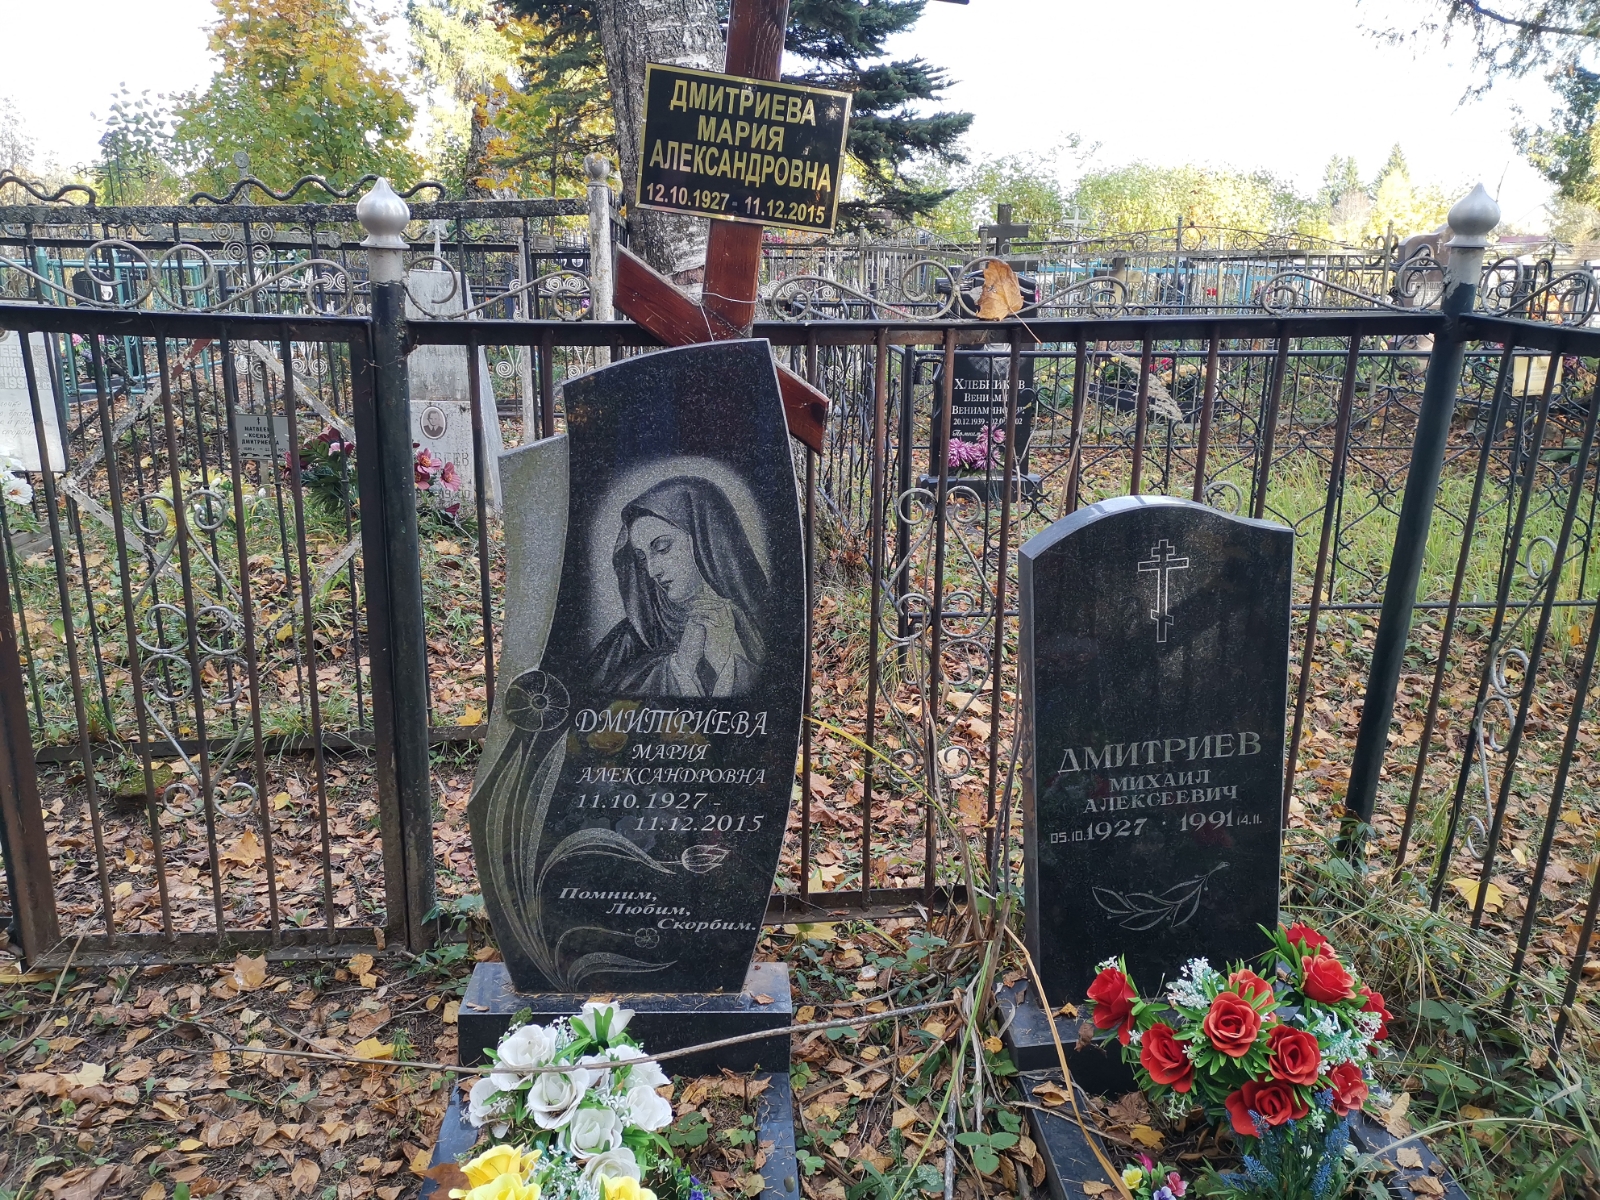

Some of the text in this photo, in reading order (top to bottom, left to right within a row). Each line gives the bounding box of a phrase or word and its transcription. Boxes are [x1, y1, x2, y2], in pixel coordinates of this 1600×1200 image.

[669, 79, 816, 126] ДМИТРИЕВА
[697, 115, 785, 152] МАРИЯ
[649, 139, 831, 193] АЛЕКСАНДРОВНА
[647, 182, 730, 211] 12.10.1927
[744, 196, 826, 224] 11.12.2015
[575, 707, 769, 738] ДМИТРИЕВА
[632, 743, 711, 763] МАРИЯ
[1057, 731, 1262, 774] ДМИТРИЕВ
[576, 767, 766, 785] АЛЕКСАНДРОВНА
[1109, 769, 1211, 793] МИХАИЛ
[576, 792, 709, 810] 11.10.1927
[1083, 785, 1238, 814] АЛЕКСЕЕВИЧ
[634, 814, 766, 832] 11.12.2015
[559, 887, 658, 902] Помним,
[606, 903, 692, 917] Любим,
[657, 917, 757, 933] Скорбим.
